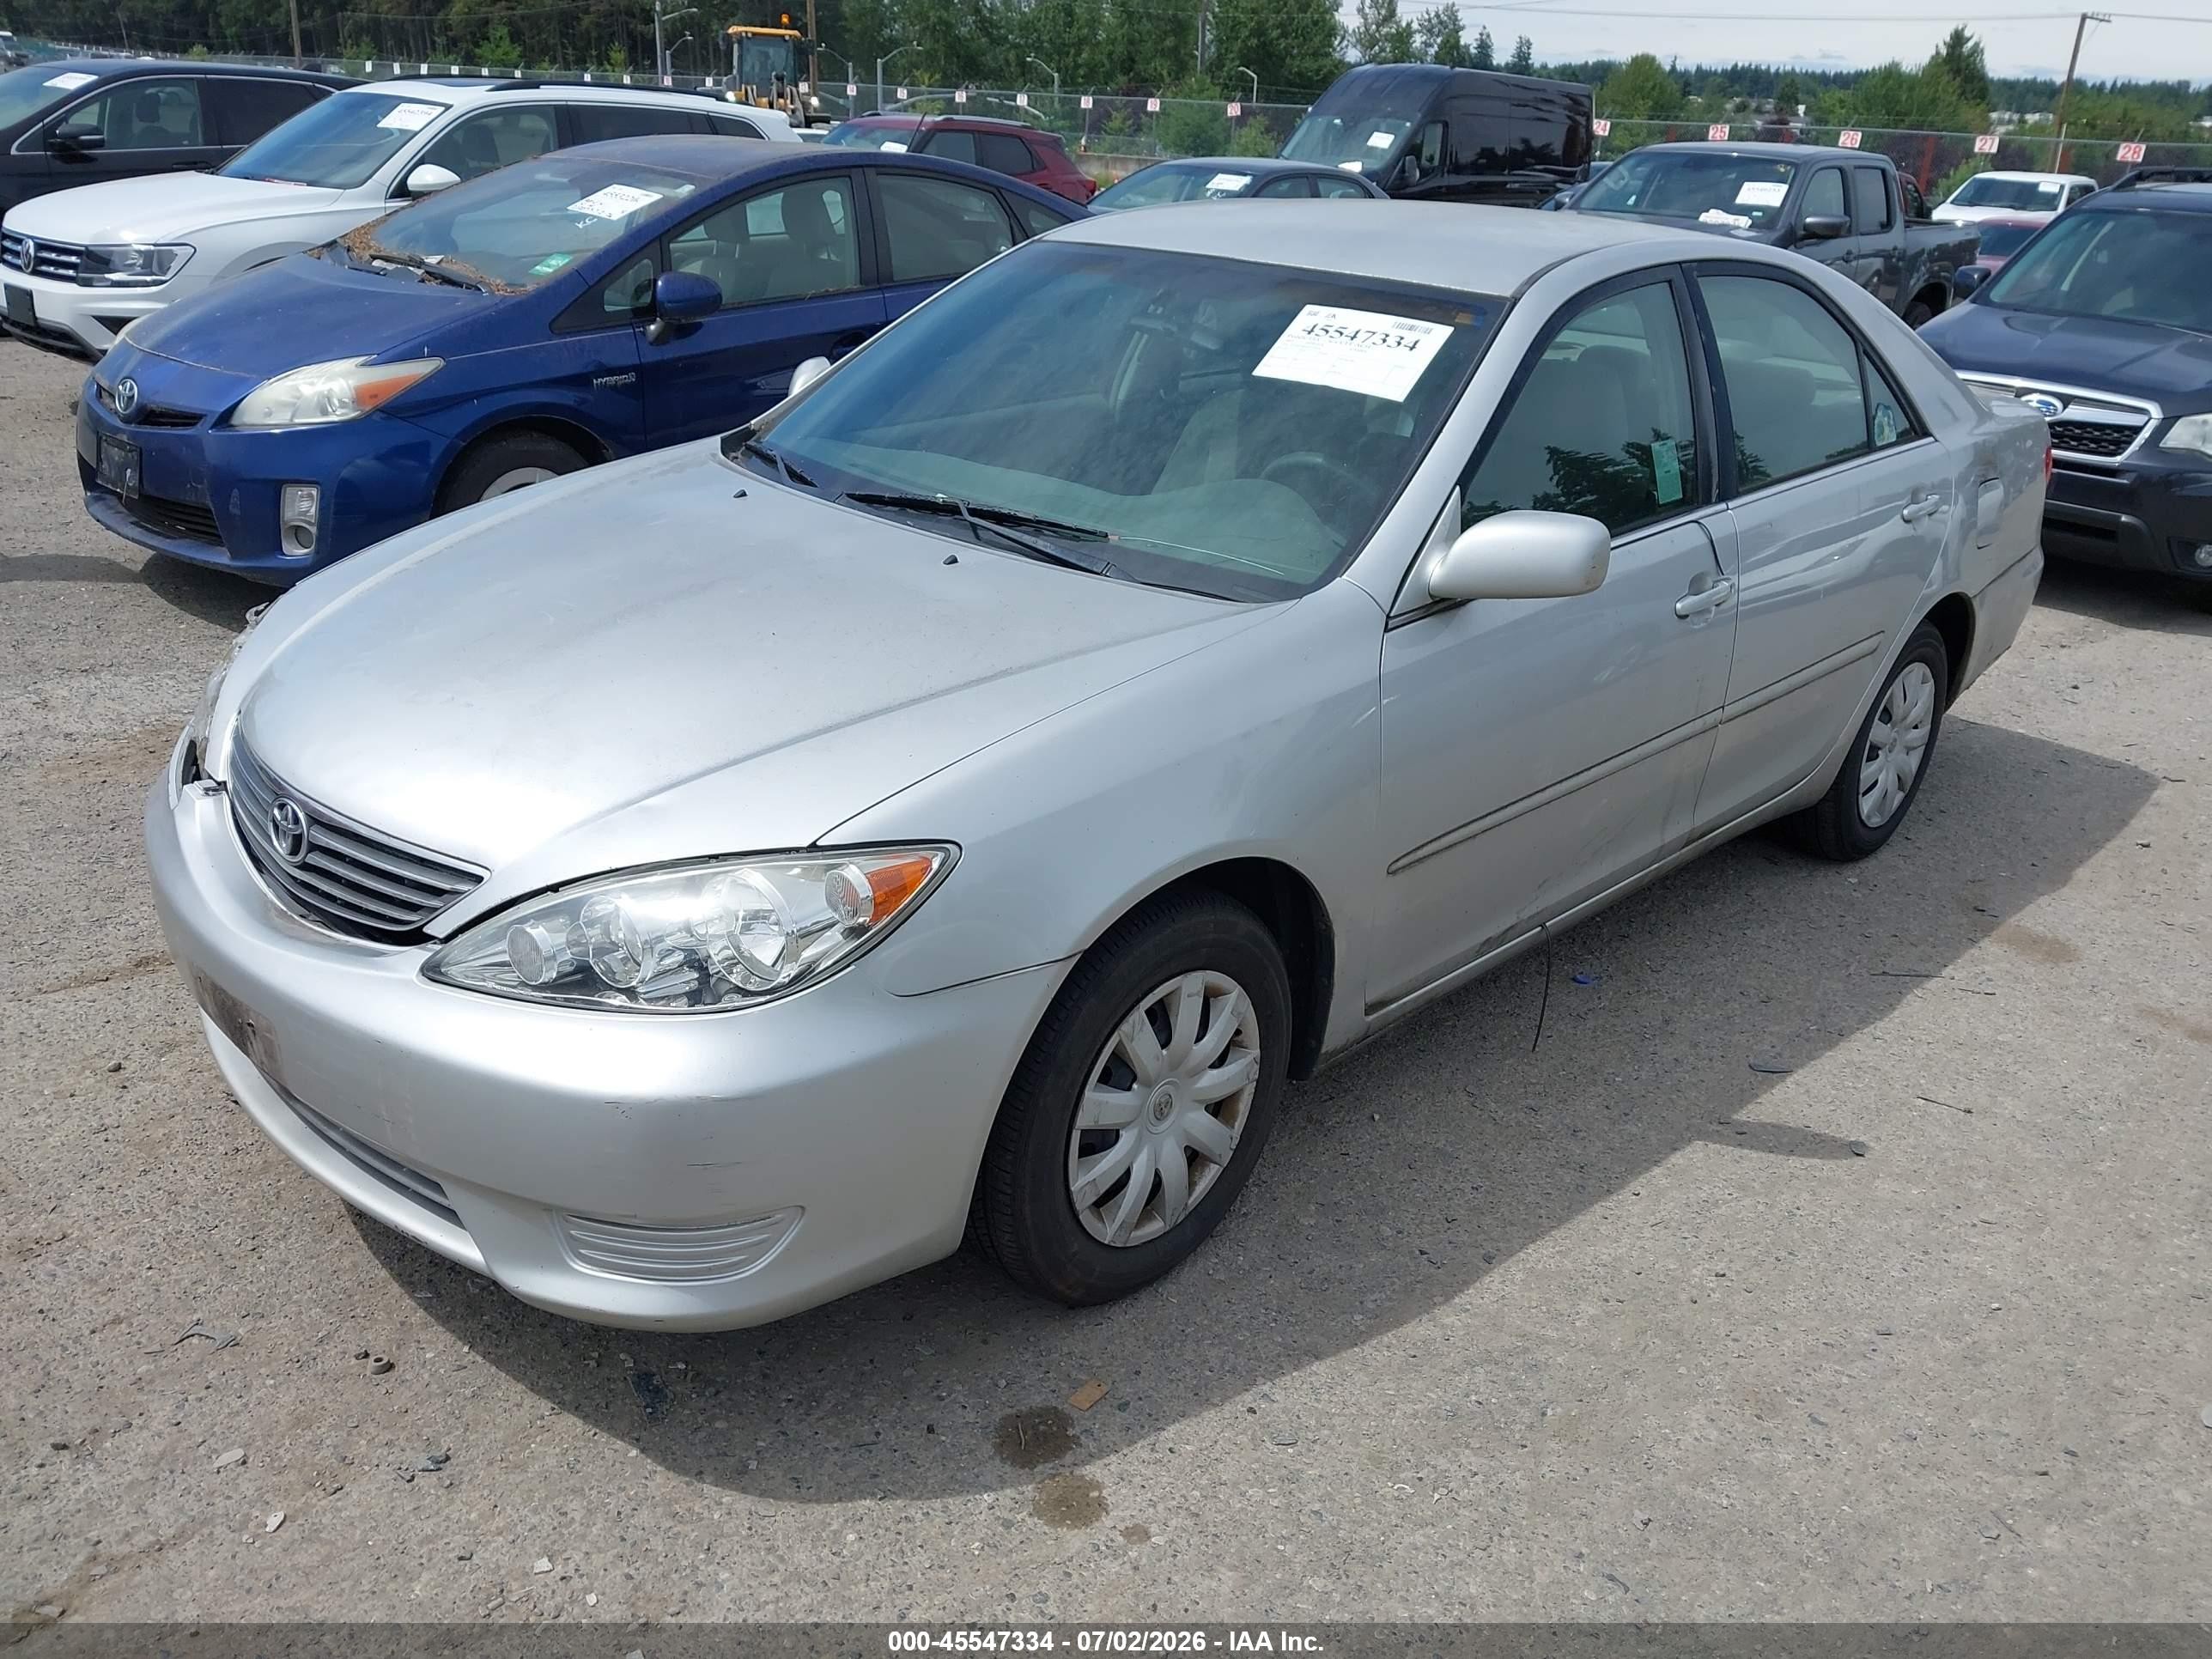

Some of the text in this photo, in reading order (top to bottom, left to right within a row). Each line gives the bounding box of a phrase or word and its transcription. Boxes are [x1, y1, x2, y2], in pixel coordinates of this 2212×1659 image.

[1228, 103, 1240, 115] 20
[1593, 120, 1608, 134] 24
[1710, 125, 1726, 139] 25
[1840, 131, 1858, 147] 26
[1977, 137, 1997, 152] 27
[2118, 144, 2143, 161] 28
[1301, 322, 1421, 352] 45547334
[592, 374, 632, 386] HYBRID
